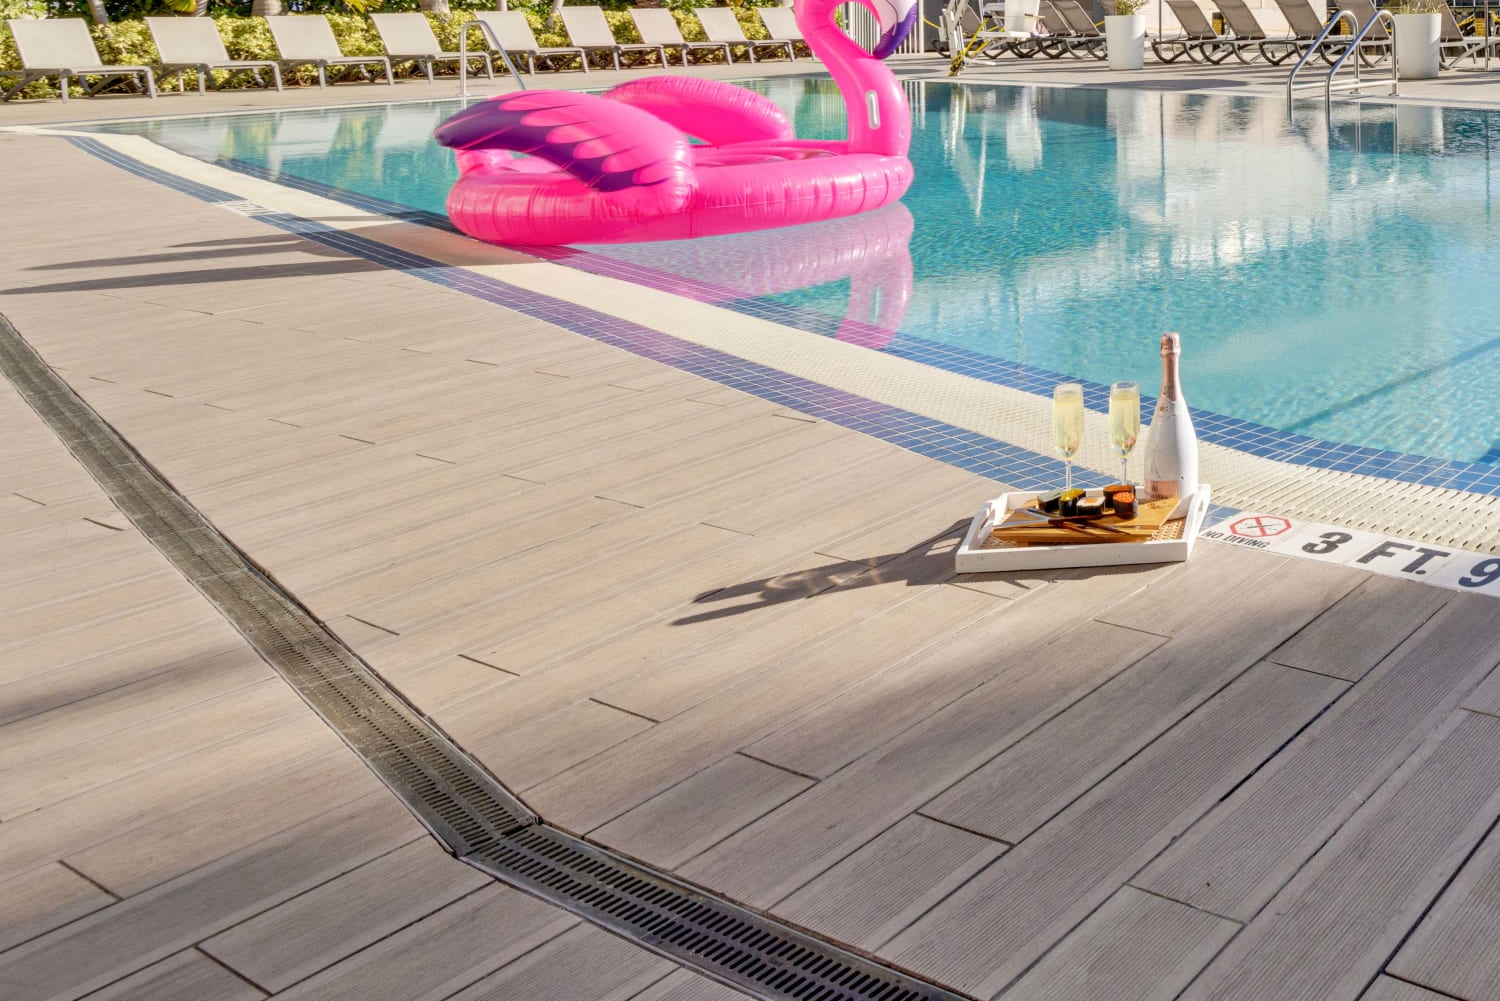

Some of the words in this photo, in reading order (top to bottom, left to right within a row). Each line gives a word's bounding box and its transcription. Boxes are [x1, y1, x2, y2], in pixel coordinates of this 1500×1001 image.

[1201, 530, 1225, 539] NO
[1222, 535, 1271, 548] DIVING
[1302, 531, 1353, 555] 3
[1356, 540, 1453, 576] FT.
